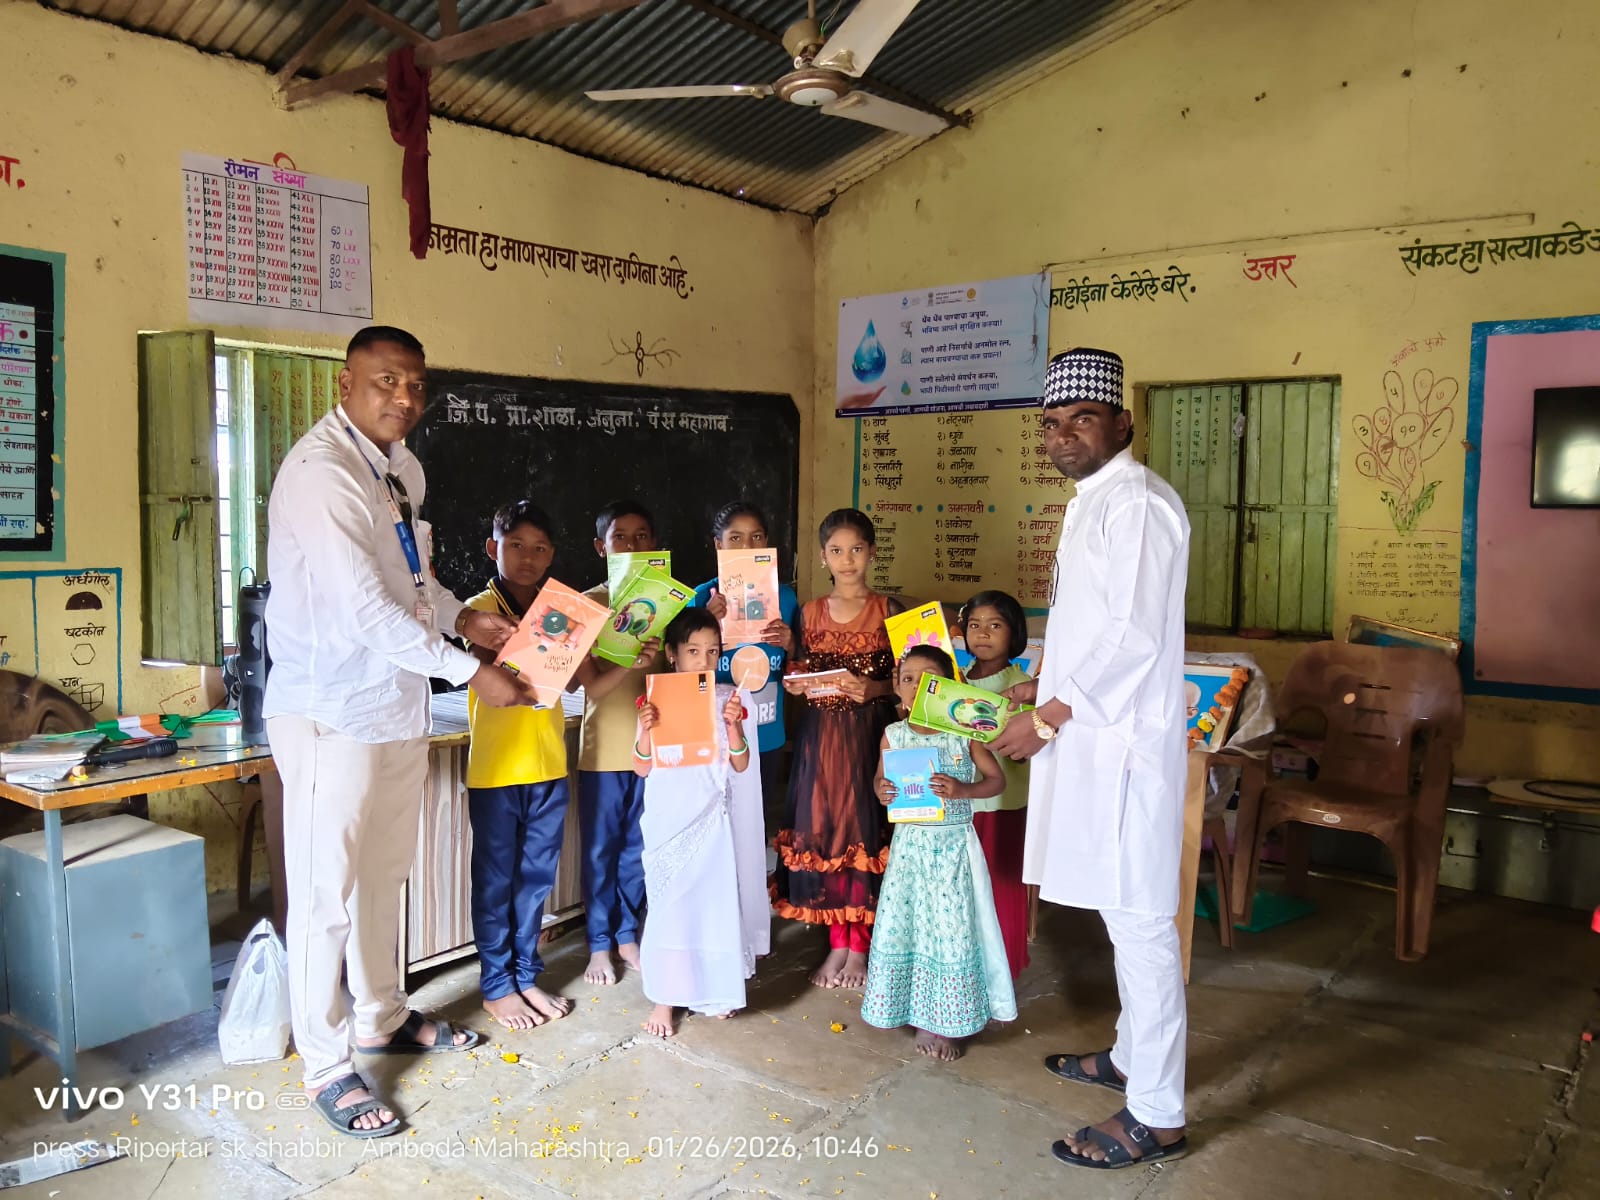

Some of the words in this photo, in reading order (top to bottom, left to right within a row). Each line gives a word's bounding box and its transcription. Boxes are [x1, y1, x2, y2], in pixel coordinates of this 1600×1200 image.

[224, 159, 259, 180] रोमन
[272, 169, 307, 189] संख्या
[228, 191, 235, 199] 22
[228, 202, 235, 210] 23
[228, 213, 236, 221] 24
[331, 225, 341, 235] 60
[228, 236, 235, 244] 26
[331, 241, 340, 249] 70
[330, 254, 340, 265] 80
[229, 265, 236, 273] 28
[480, 232, 499, 271] हा
[501, 237, 578, 278] माणसाचा
[580, 251, 613, 282] खरा
[614, 252, 658, 285] दागिना
[658, 255, 694, 299] आहे.
[1243, 254, 1297, 288] उत्तर
[329, 267, 340, 278] 90
[330, 280, 342, 289] 100
[1111, 269, 1160, 302] केलेले
[1161, 265, 1196, 302] बरे.
[921, 345, 934, 353] पाणी
[936, 344, 947, 352] आहे
[948, 500, 984, 514] अमरावती
[63, 571, 110, 588] अर्धगोल
[64, 623, 107, 638] षटकोन
[770, 655, 781, 671] 92
[59, 677, 82, 688] घन
[904, 783, 925, 795] HIKE
